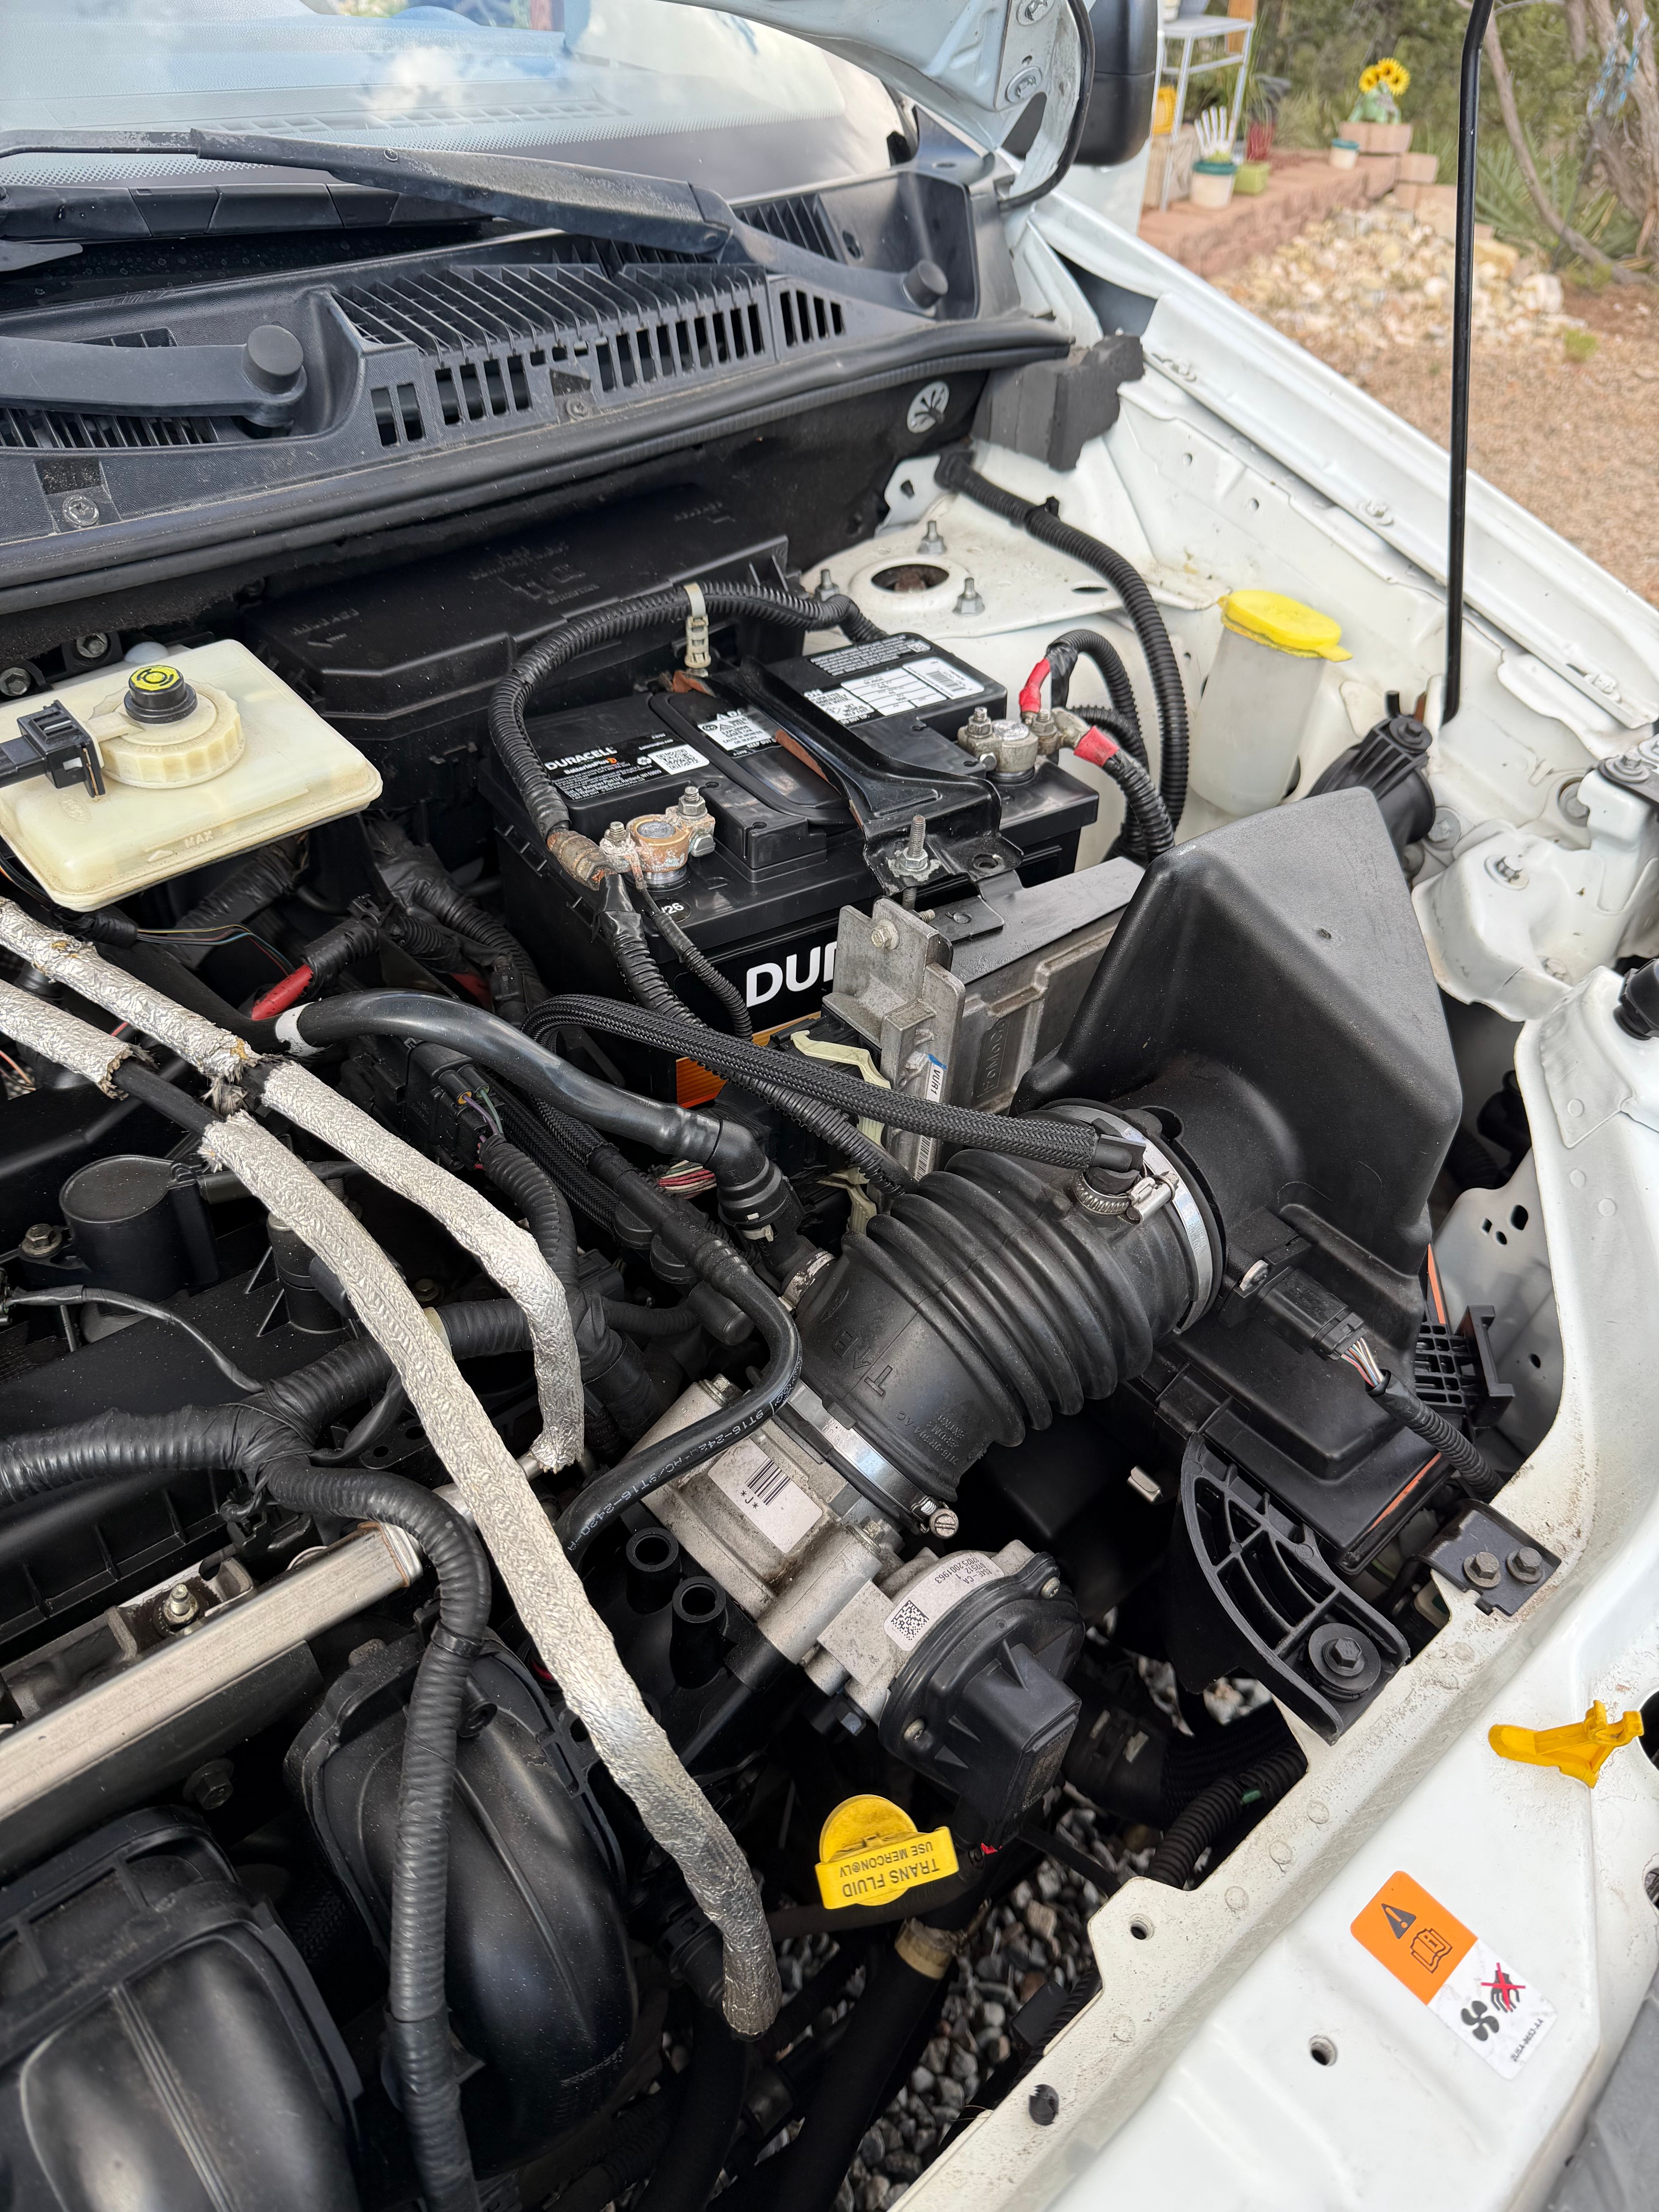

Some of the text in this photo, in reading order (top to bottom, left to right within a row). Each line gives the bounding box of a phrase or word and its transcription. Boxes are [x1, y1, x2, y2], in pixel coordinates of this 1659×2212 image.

[544, 747, 617, 770] DURACELL
[184, 830, 214, 848] MAX
[910, 1841, 933, 1856] USE
[842, 1858, 940, 1897] TRANS FLUID
